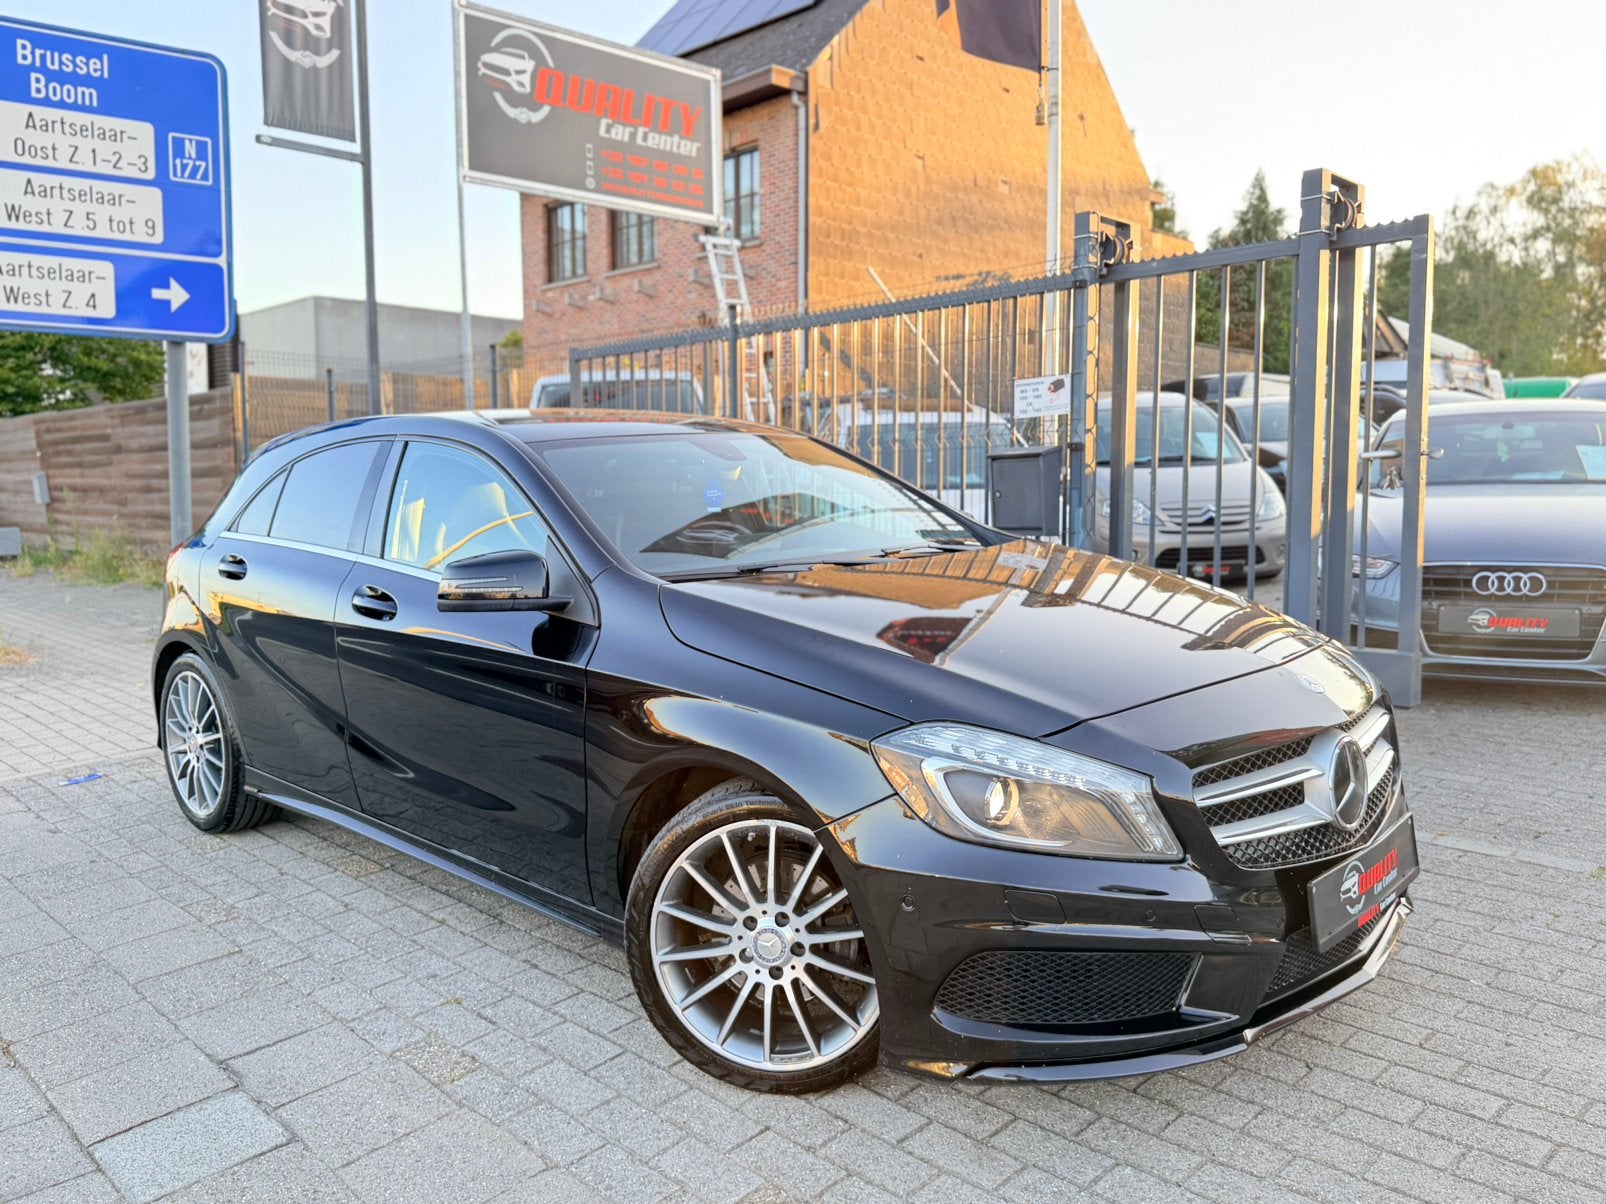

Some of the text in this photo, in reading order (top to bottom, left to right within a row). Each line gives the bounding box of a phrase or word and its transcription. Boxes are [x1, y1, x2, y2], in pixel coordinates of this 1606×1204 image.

[15, 38, 110, 79] Brussel
[30, 72, 98, 108] Boom
[535, 68, 702, 137] QUALITY
[24, 111, 138, 145] Aartselaar-
[598, 117, 702, 158] Car Center
[13, 137, 58, 163] Oost
[184, 138, 197, 160] N
[174, 158, 207, 181] 177
[23, 178, 137, 208] Aartselaar-
[4, 203, 53, 228] West
[108, 215, 136, 236] tot
[144, 218, 157, 238] 9
[3, 284, 52, 308] West
[1488, 617, 1549, 628] QUALITY
[1359, 848, 1397, 895] QUALITY
